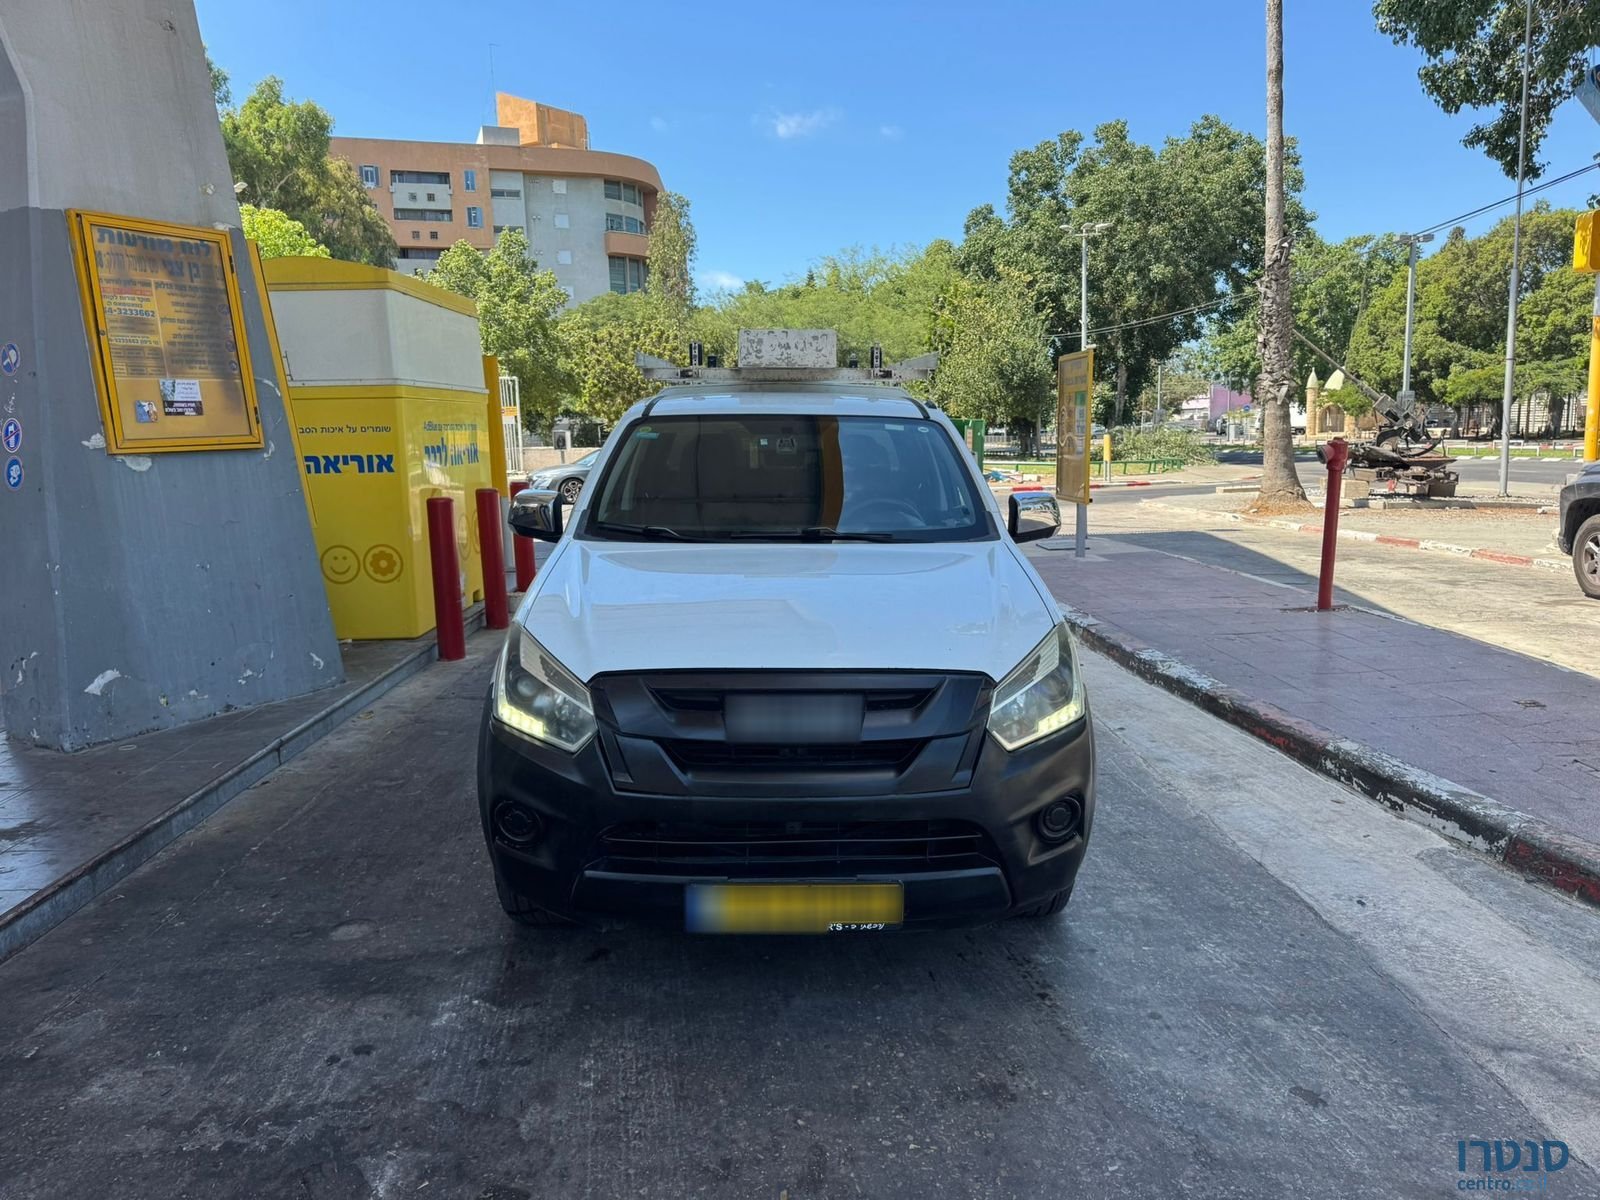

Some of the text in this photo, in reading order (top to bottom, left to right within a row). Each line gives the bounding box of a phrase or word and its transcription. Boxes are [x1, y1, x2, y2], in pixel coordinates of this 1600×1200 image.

[96, 227, 174, 252] מודעות
[320, 425, 344, 434] איכות
[346, 424, 358, 434] על
[360, 424, 392, 434] שומרים
[304, 454, 395, 474] אוריאה
